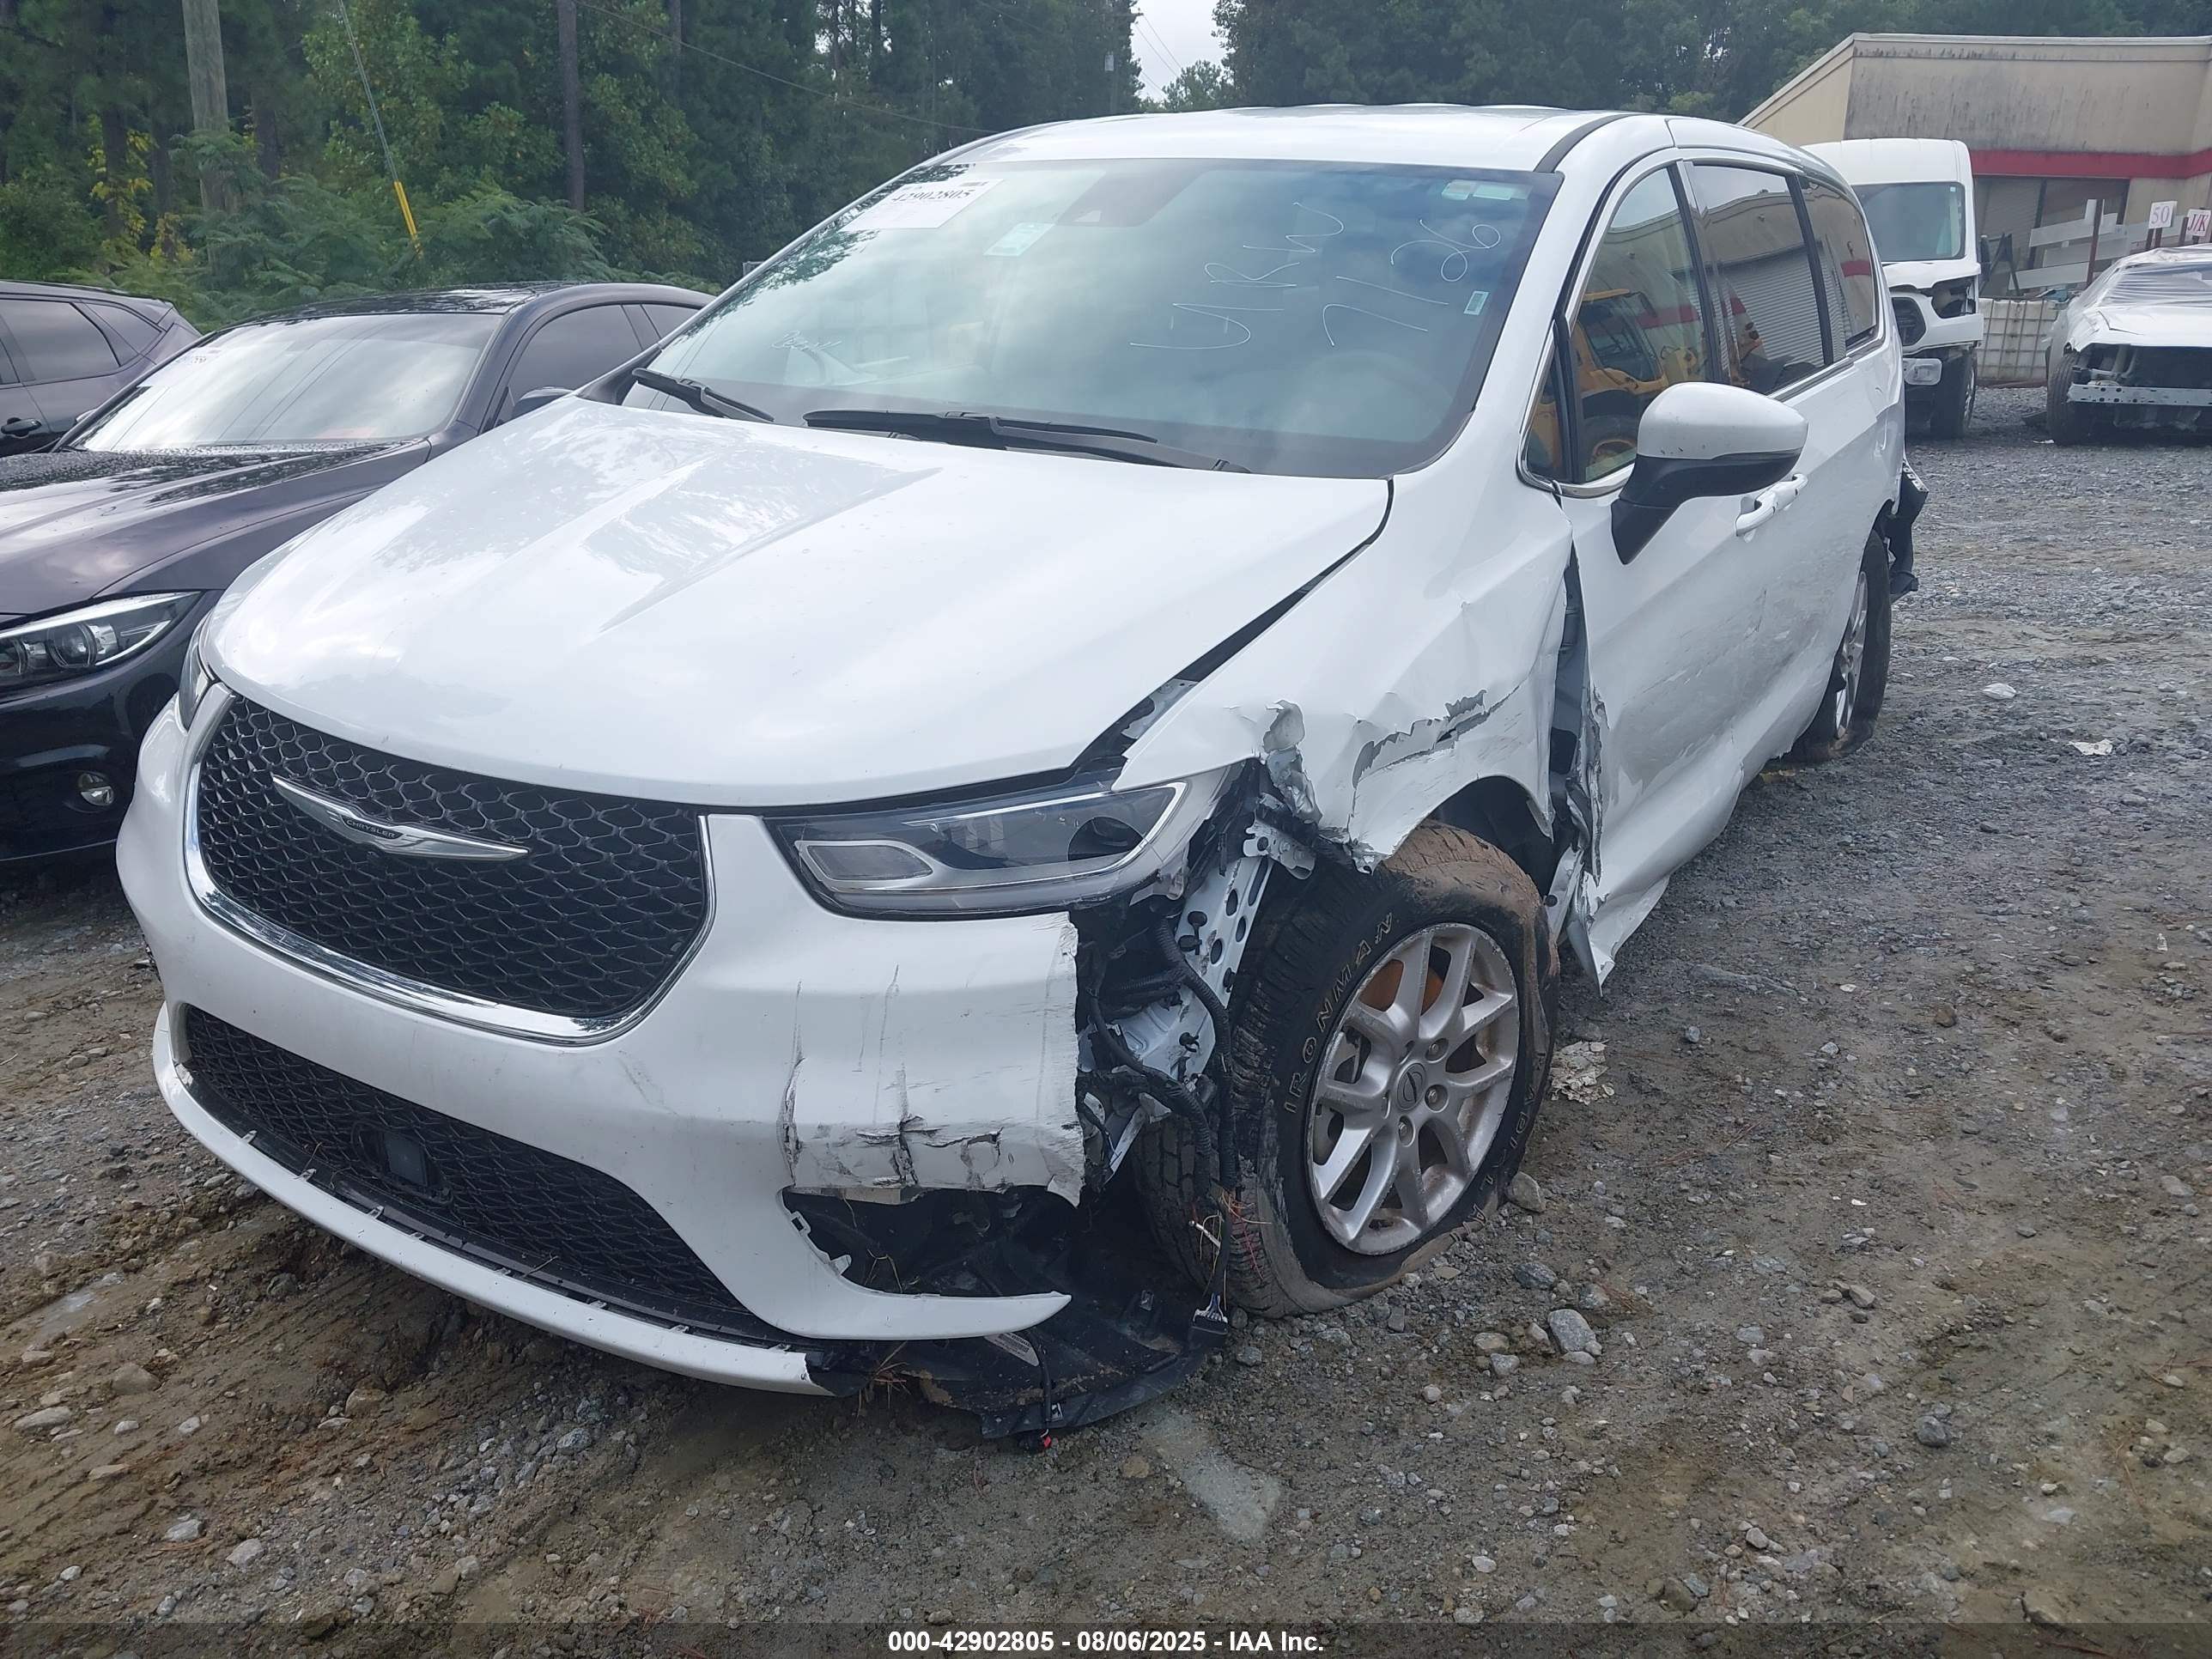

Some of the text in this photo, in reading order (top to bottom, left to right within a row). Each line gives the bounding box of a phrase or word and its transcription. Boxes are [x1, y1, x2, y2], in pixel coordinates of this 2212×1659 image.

[2151, 205, 2170, 224] 50
[2187, 214, 2209, 233] J/K
[346, 819, 396, 838] CHRYSLER
[1284, 912, 1393, 1114] IRONMAN
